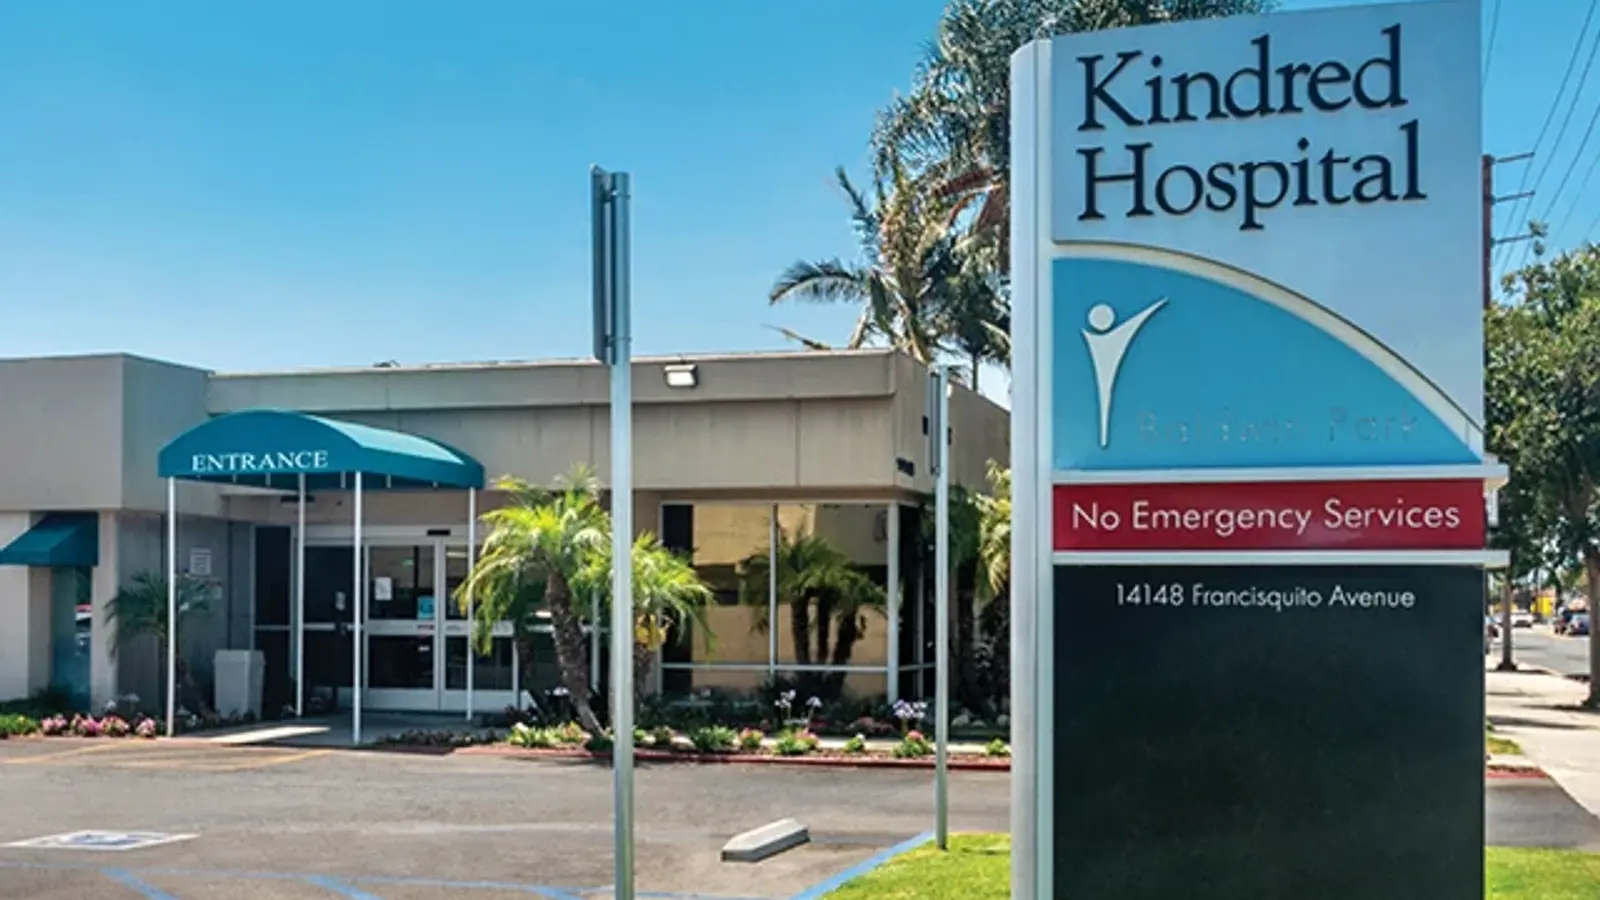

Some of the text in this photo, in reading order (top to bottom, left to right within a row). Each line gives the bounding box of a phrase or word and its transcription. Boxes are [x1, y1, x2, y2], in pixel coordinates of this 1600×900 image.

[1076, 23, 1408, 132] Kindred
[1076, 119, 1428, 231] Hospital
[1327, 404, 1421, 444] Park
[191, 449, 329, 473] ENTRANCE
[1072, 498, 1461, 537] No Emergency Services
[1115, 583, 1416, 612] 14148 Francisquito Avenue
